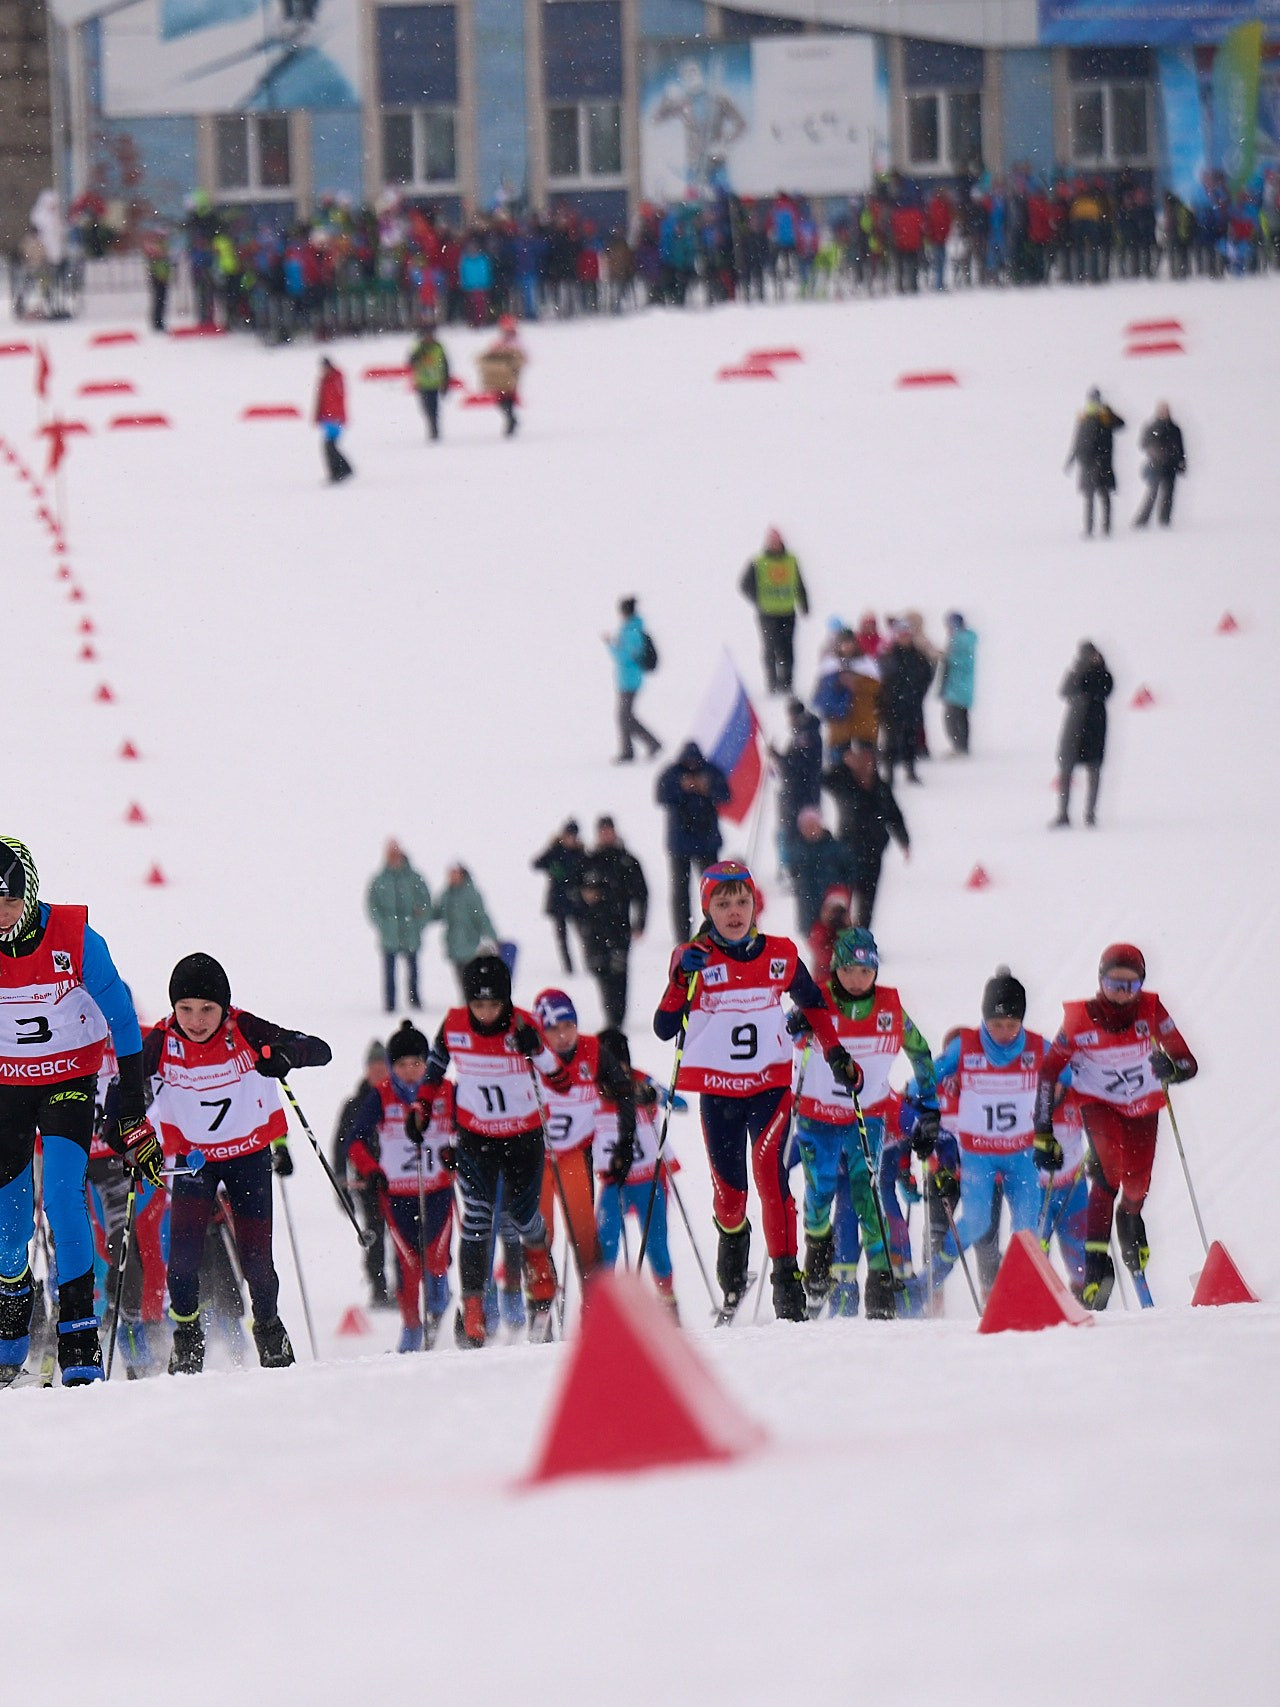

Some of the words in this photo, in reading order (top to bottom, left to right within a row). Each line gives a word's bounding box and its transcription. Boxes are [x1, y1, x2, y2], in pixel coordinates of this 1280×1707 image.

[15, 1016, 53, 1045] 3
[730, 1023, 758, 1060] 9
[477, 1085, 506, 1113] 11
[200, 1097, 232, 1132] 7
[982, 1103, 1017, 1132] 15
